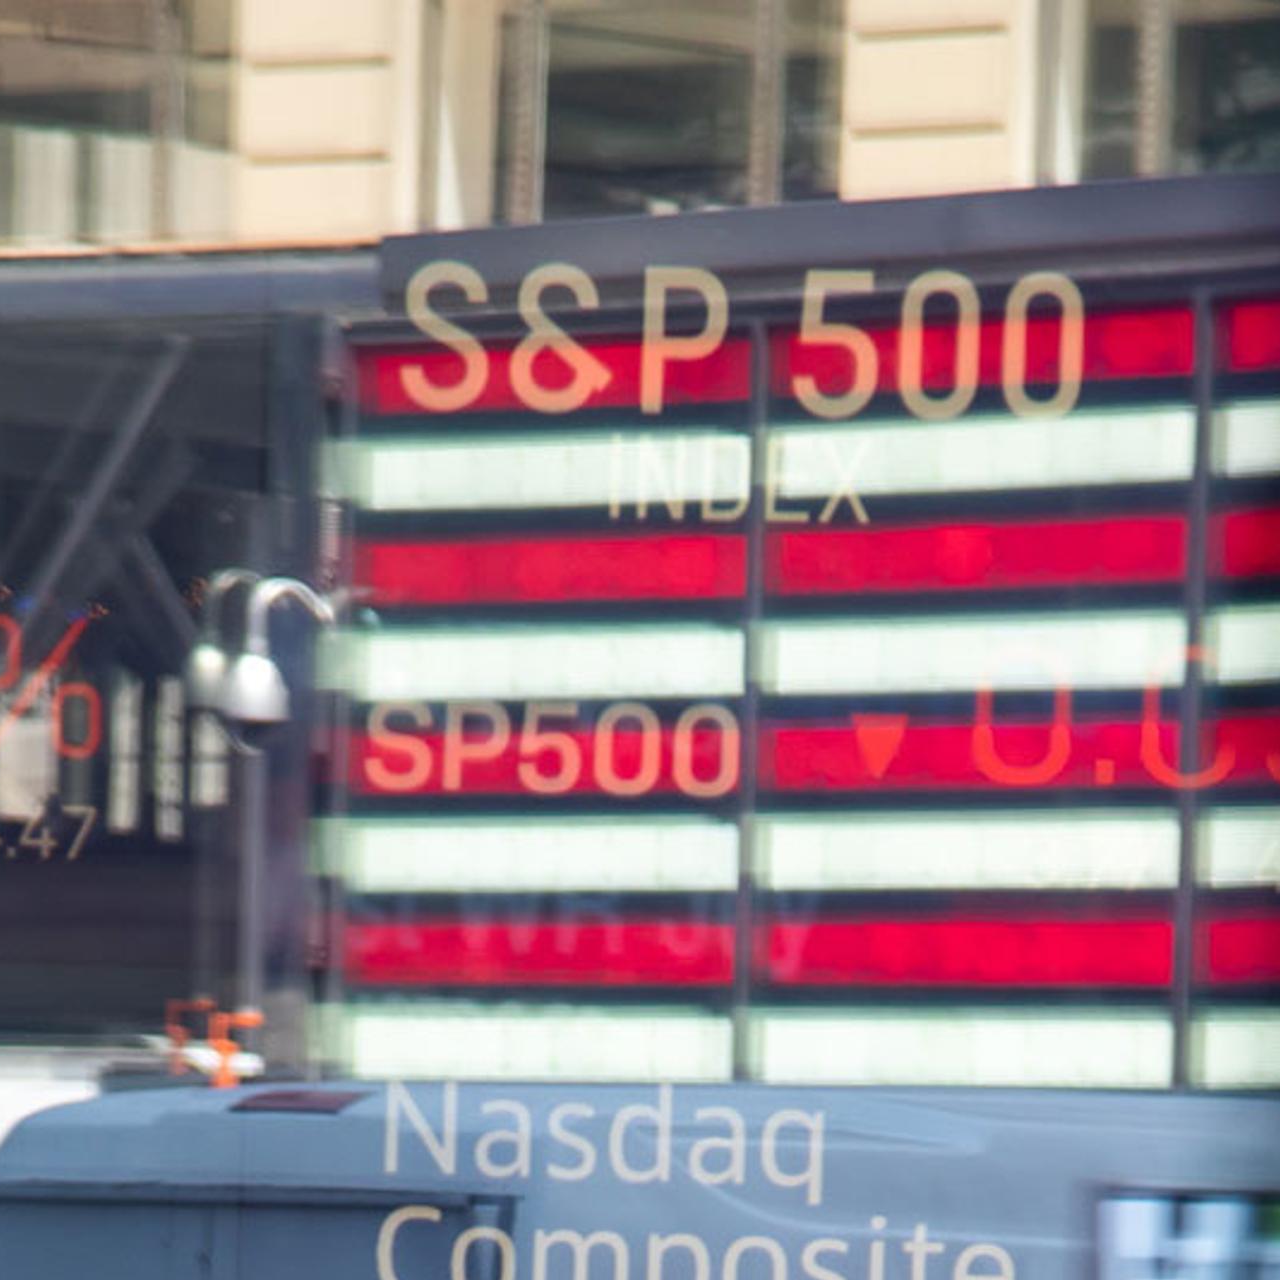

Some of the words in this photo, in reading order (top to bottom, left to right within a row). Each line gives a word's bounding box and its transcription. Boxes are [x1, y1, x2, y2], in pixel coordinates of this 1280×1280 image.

[400, 261, 730, 415] S&P
[789, 270, 1087, 420] 500
[607, 432, 870, 525] INDEX
[362, 700, 740, 798] SP500
[381, 1079, 827, 1206] Nasdaq
